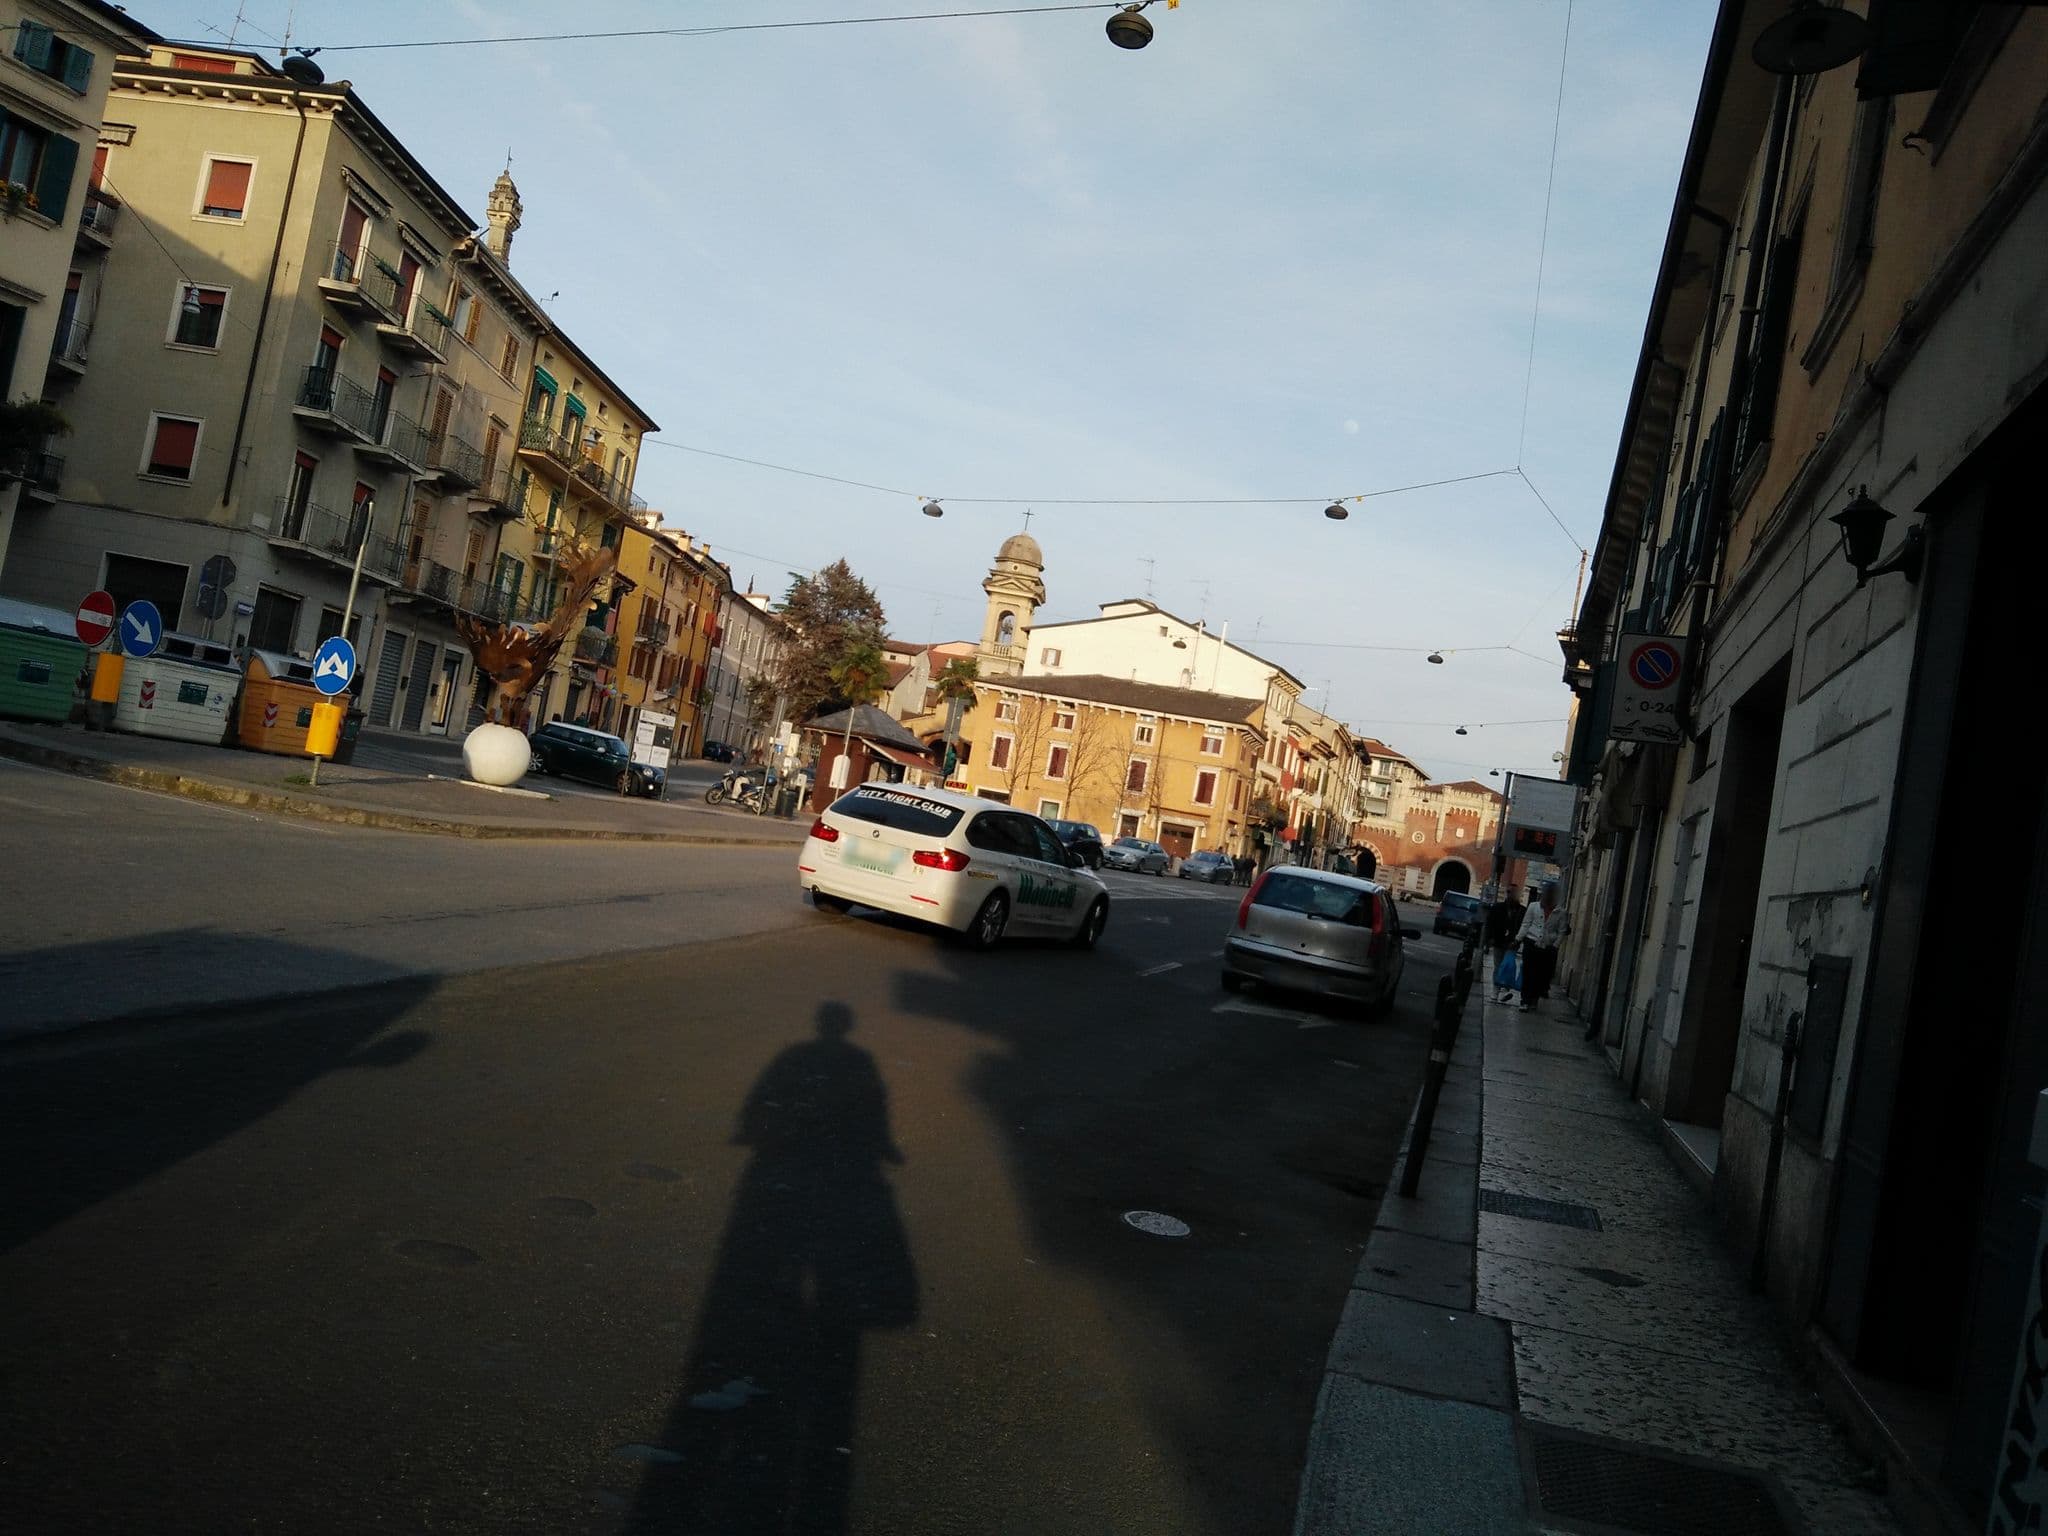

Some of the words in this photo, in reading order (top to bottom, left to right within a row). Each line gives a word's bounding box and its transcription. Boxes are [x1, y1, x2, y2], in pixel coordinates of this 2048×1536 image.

[1640, 701, 1674, 714] 0-24
[947, 781, 967, 789] TAXI
[856, 789, 884, 798] CITY
[884, 792, 921, 806] NIGHT
[921, 801, 952, 816] CLUB
